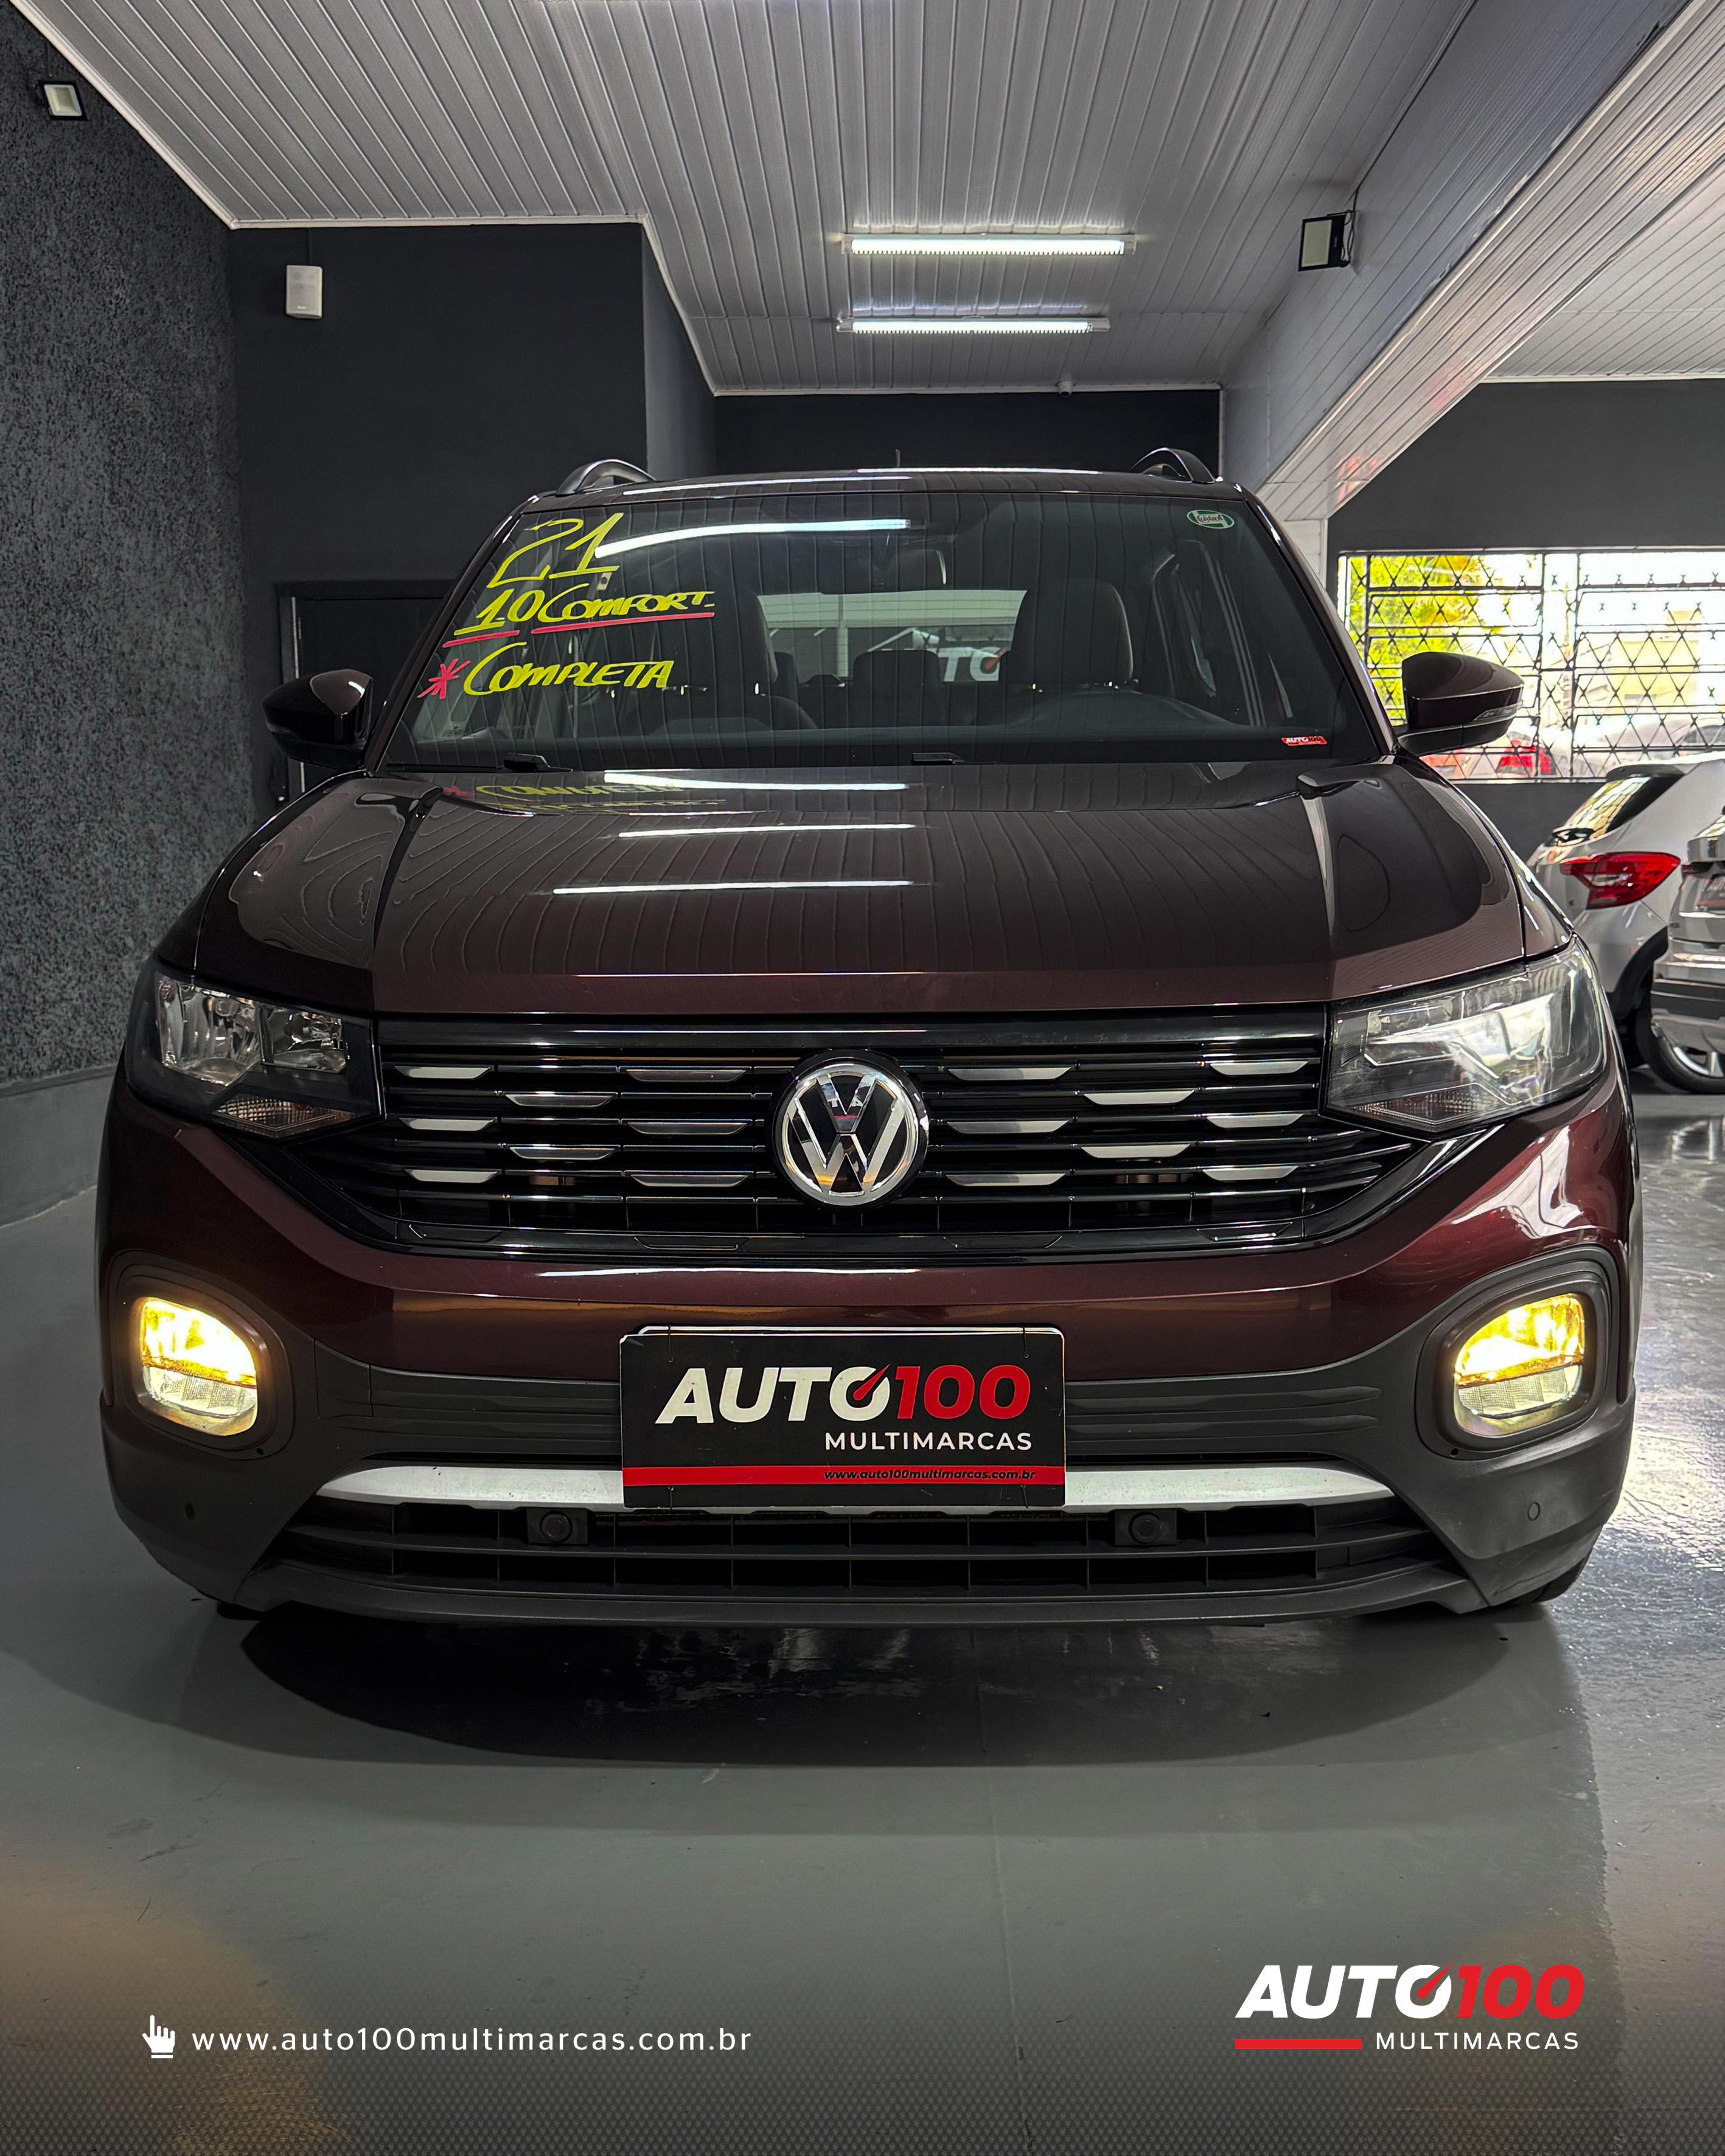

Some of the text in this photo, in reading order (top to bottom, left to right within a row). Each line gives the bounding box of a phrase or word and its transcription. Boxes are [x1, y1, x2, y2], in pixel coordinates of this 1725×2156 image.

[486, 512, 624, 588] 21
[463, 642, 674, 696] COMPLETA
[655, 1365, 1031, 1424] AUTO100
[825, 1432, 1032, 1450] MULTIMARCAS
[824, 1469, 1036, 1480] www.auto100multimarcas.com.br
